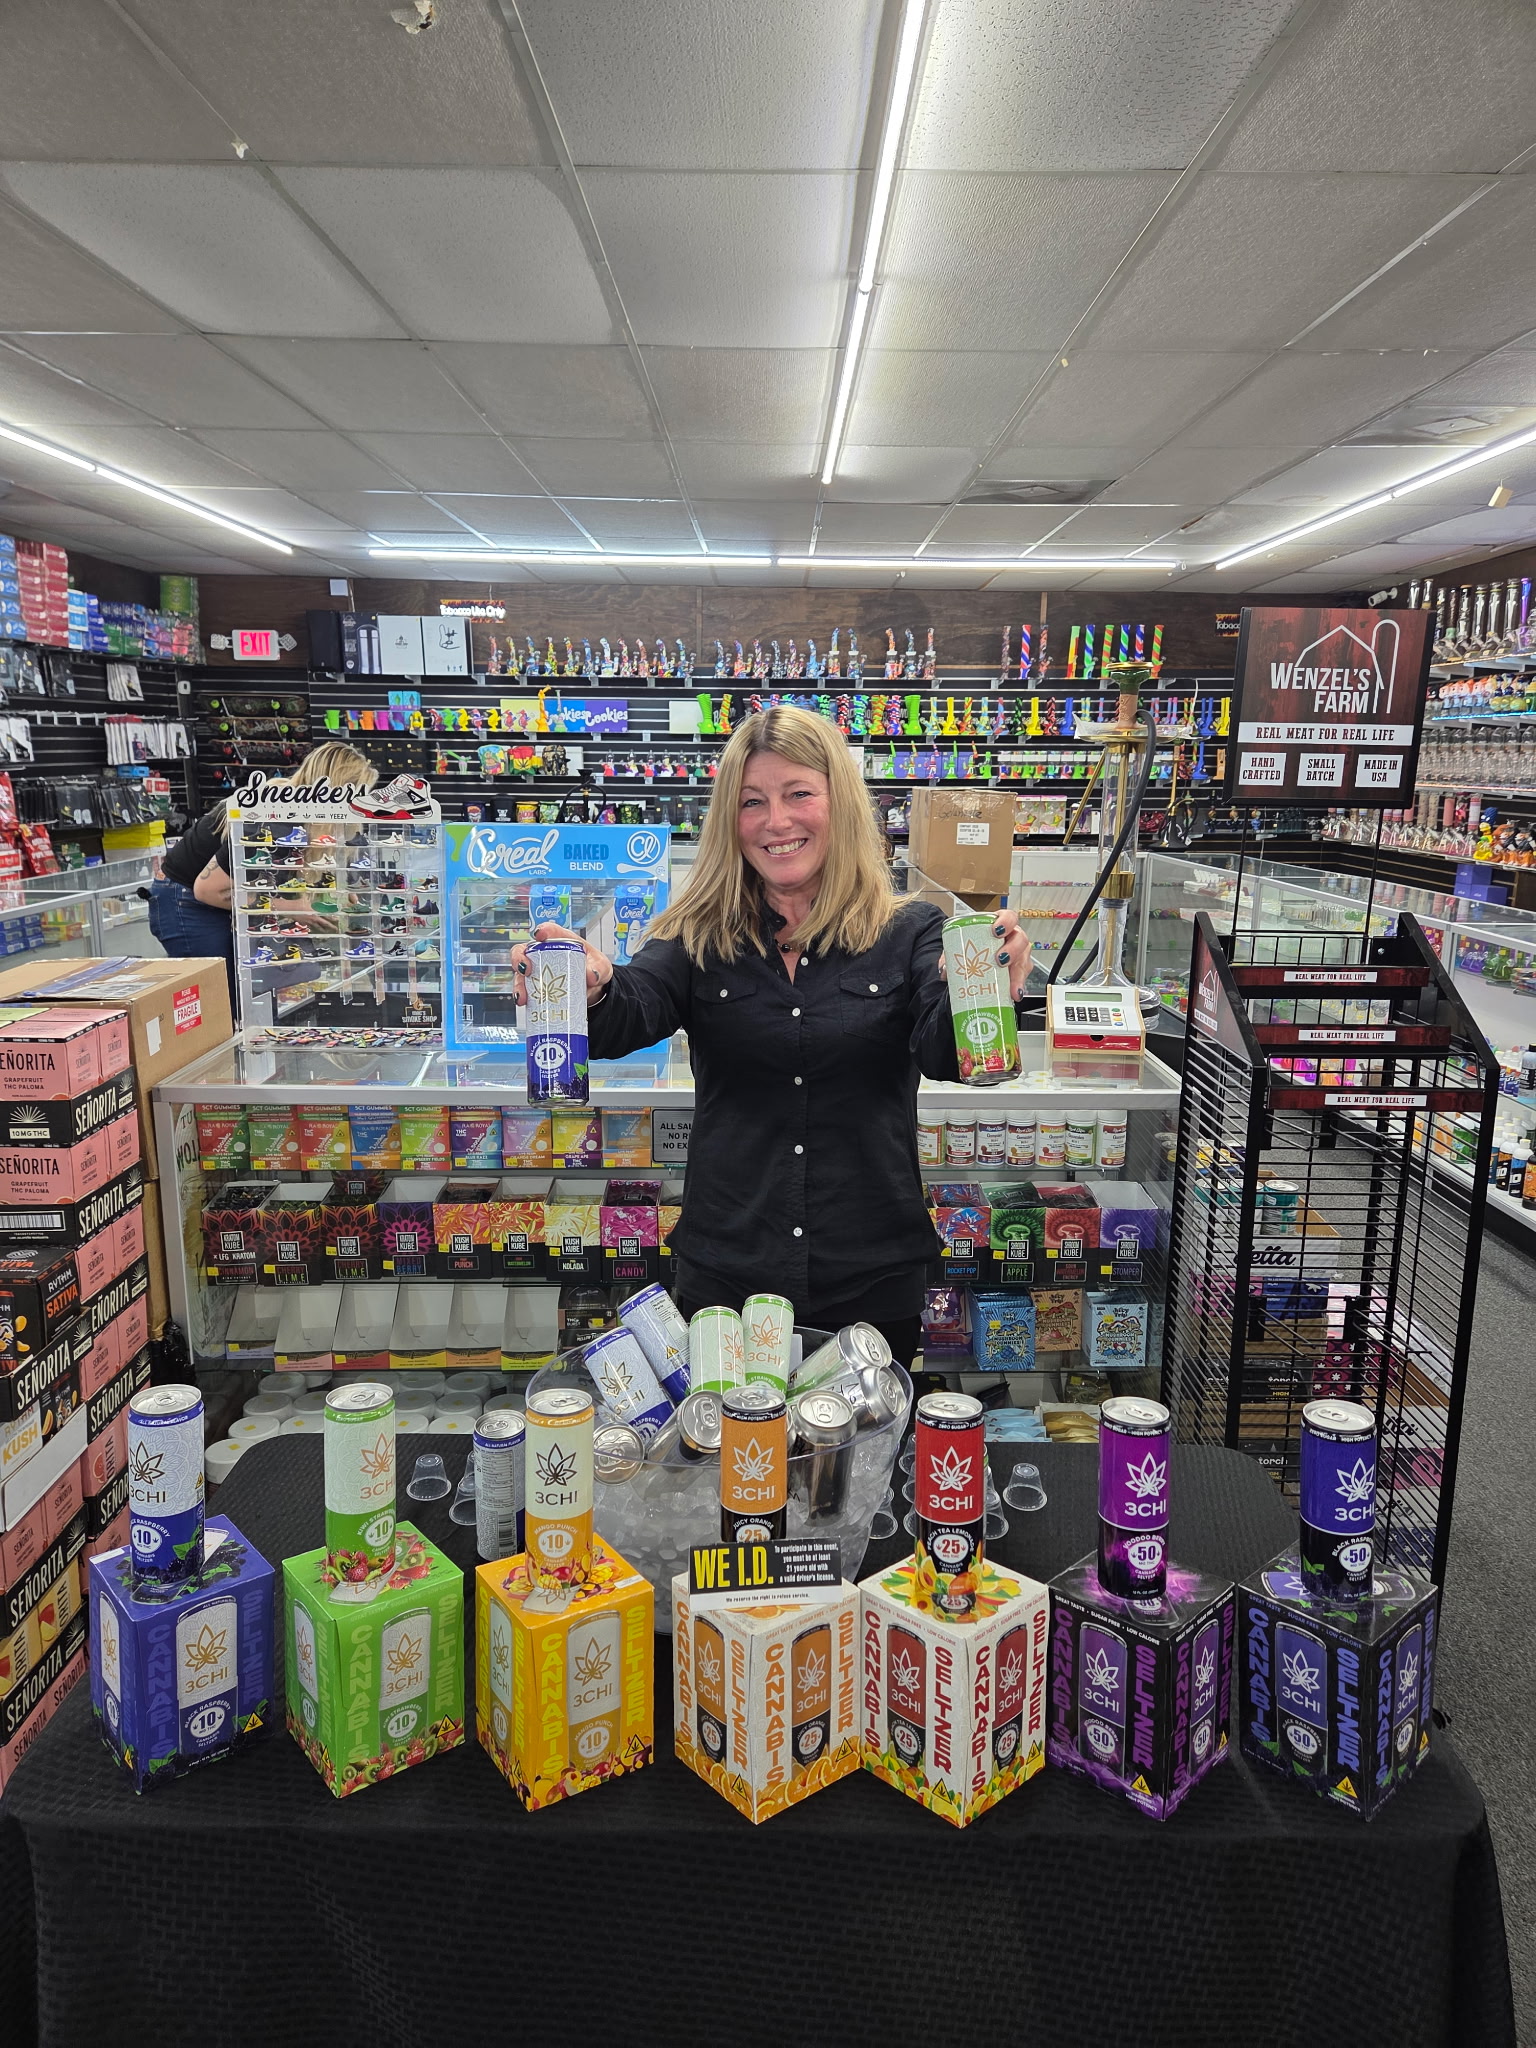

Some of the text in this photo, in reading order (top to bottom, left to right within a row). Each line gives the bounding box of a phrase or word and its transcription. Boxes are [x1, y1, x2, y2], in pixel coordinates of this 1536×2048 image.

[240, 632, 270, 656] EXIT
[1271, 663, 1371, 691] WENZEL'S
[1314, 692, 1369, 714] FARM
[585, 707, 627, 726] Cookies
[1256, 727, 1394, 741] REAL MEAT FOR REAL LIFE
[1251, 758, 1274, 767] HAND
[1307, 759, 1336, 769] SMALL
[1364, 760, 1398, 770] MADE IN
[1242, 770, 1281, 780] CRAFTED
[1306, 771, 1334, 781] BATCH
[1371, 773, 1387, 782] USA
[237, 772, 366, 808] Sneakers
[466, 828, 560, 874] Cereal
[563, 844, 610, 860] BAKED
[569, 862, 604, 871] BLEND
[178, 1003, 198, 1021] FRAGILE
[75, 1086, 116, 1135] SEÑORITA
[79, 1184, 124, 1238] SEÑORITA
[223, 1234, 240, 1242] KRATOM
[225, 1242, 241, 1250] KUBE
[400, 1242, 416, 1250] KUBE
[455, 1236, 469, 1244] KUSH
[455, 1243, 470, 1251] KUBE
[511, 1234, 525, 1242] KUSH
[622, 1239, 637, 1247] KUSH
[281, 1244, 296, 1252] KRATOM
[342, 1247, 357, 1255] KUBE
[48, 1269, 73, 1292] RYTHM
[278, 1274, 305, 1282] LIME
[338, 1268, 366, 1277] LIME
[615, 1267, 645, 1277] CANDY
[1006, 1268, 1028, 1276] APPLE
[1113, 1267, 1140, 1275] STOMPER
[46, 1284, 78, 1318] SATIVA
[17, 1340, 71, 1410] SEÑORITA
[90, 1368, 133, 1433] SEÑORITA
[535, 1491, 578, 1505] 3CHI
[732, 1486, 775, 1501] 3CHI
[929, 1494, 973, 1511] 3CHI
[1124, 1500, 1167, 1517] 3CHI
[534, 1524, 578, 1535] MANGO PUNCH
[733, 1517, 774, 1530] JUICY ORANGE
[136, 1530, 152, 1545] 10
[546, 1535, 564, 1548] 10
[927, 1530, 937, 1550] PEACH
[952, 1528, 975, 1552] LEMONADE
[941, 1539, 961, 1554] 25
[781, 1545, 806, 1553] participate
[1138, 1546, 1156, 1561] 50
[1350, 1548, 1366, 1563] 50
[694, 1545, 774, 1590] WE I.D.
[794, 1565, 807, 1573] years
[817, 1563, 828, 1571] with
[10, 1545, 64, 1628] SEÑORITA
[1055, 1595, 1160, 1646] GREAT TASTE SUGAR FREE LOW CALORIE
[435, 1593, 458, 1712] SELTZER
[479, 1586, 489, 1724] CANNABIS
[626, 1605, 646, 1727] SELTZER
[676, 1601, 693, 1743] CANNABIS
[837, 1610, 854, 1733] SELTZER
[1028, 1608, 1046, 1736] SELTZER
[1053, 1608, 1073, 1743] CANNABIS
[7, 1644, 62, 1732] SEÑORITA
[184, 1667, 229, 1694] 3CHI
[385, 1671, 423, 1697] 3CHI
[864, 1610, 881, 1748] CANNABIS
[347, 1624, 373, 1763] CANNABIS
[514, 1627, 525, 1753] SELTZER
[573, 1684, 613, 1708] 3CHI
[542, 1632, 564, 1775] CANNABIS
[730, 1639, 748, 1772] SELTZER
[796, 1689, 827, 1713] 3CHI
[891, 1688, 921, 1714] 3CHI
[1084, 1687, 1120, 1714] 3CHI
[1133, 1644, 1157, 1771] SELTZER
[1282, 1686, 1320, 1714] 3CHI
[184, 1699, 231, 1729] BLACK RASPBERRY
[765, 1643, 785, 1787] CANNABIS
[933, 1646, 954, 1775] SELTZER
[971, 1645, 991, 1792] CANNABIS
[199, 1711, 216, 1730] 10
[393, 1713, 410, 1730] 10
[14, 1709, 47, 1763] SEÑORITA
[585, 1731, 601, 1747] 10
[803, 1733, 818, 1746] 25
[898, 1731, 913, 1749] 25
